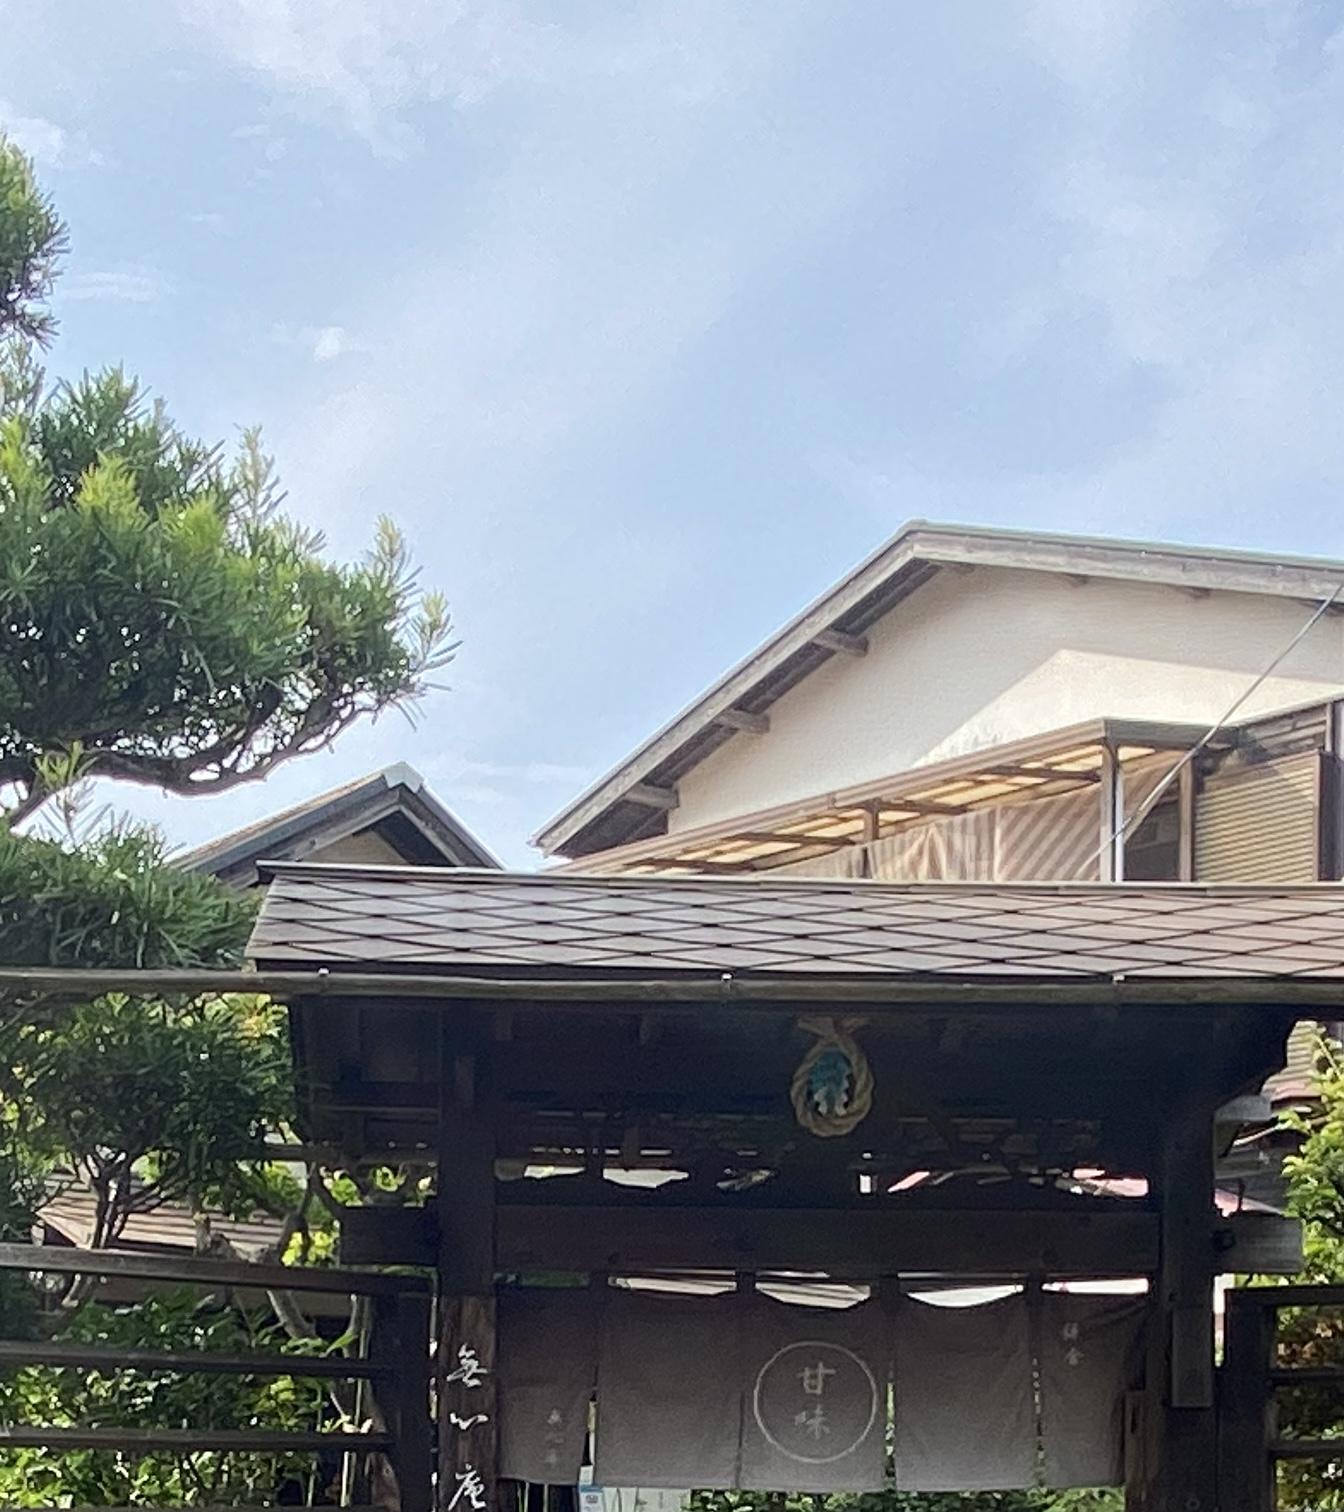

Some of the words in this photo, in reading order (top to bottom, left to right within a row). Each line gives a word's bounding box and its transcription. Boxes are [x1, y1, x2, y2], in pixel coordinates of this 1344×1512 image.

[446, 1342, 490, 1512] 無心庵
[794, 1361, 837, 1440] 甘味
